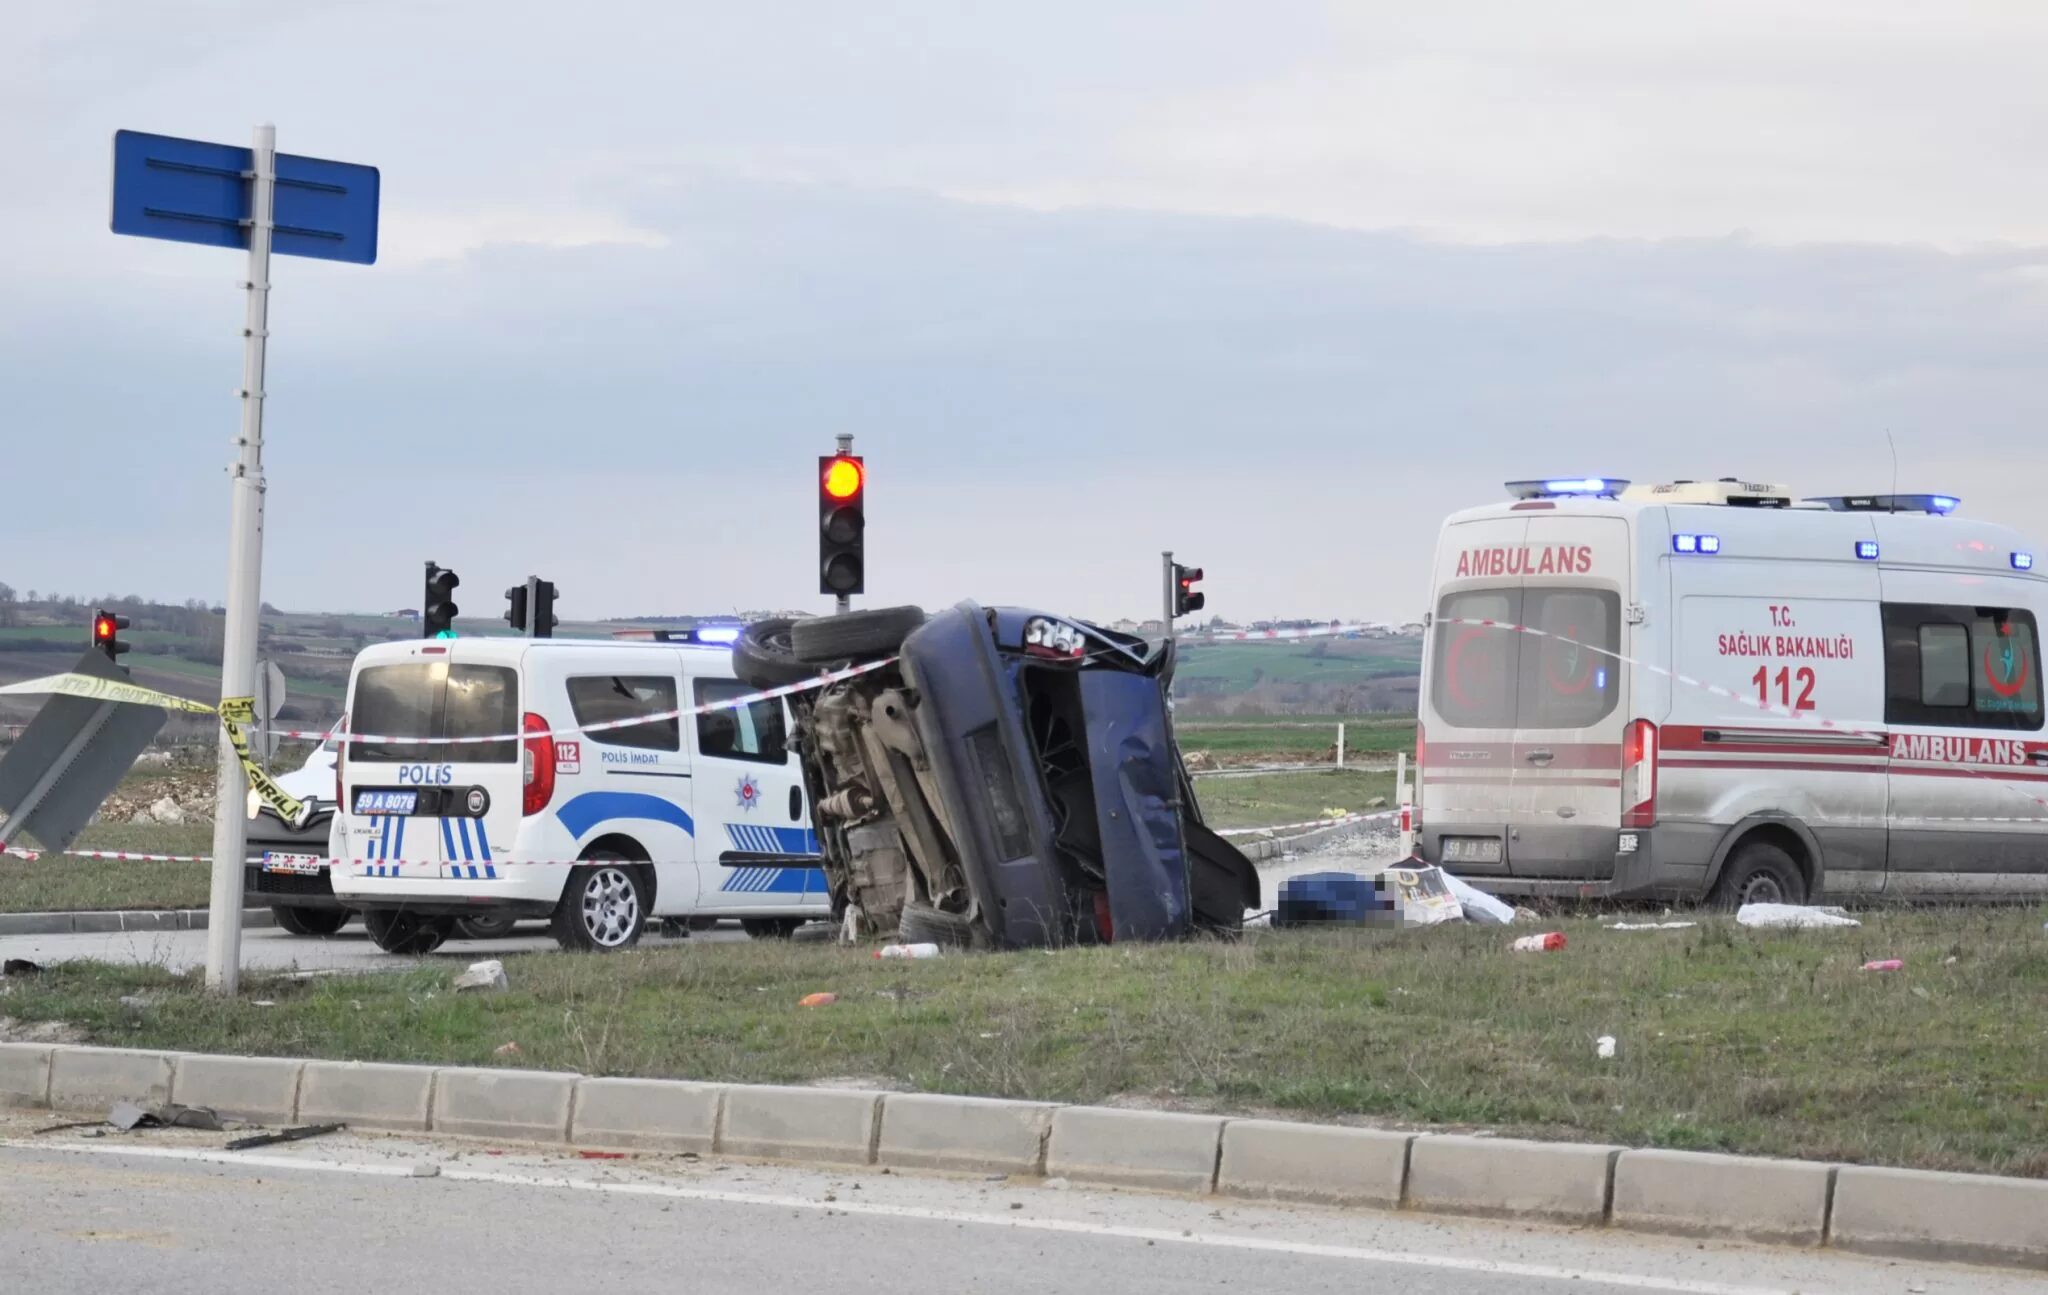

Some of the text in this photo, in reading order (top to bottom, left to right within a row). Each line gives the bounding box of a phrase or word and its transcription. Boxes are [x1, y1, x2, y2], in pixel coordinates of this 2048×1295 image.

[1456, 545, 1592, 577] AMBULANS
[1769, 606, 1796, 627] T.C.
[1718, 629, 1853, 660] SAĞLIK BAKANLIĞI
[1752, 665, 1816, 711] 112
[557, 744, 577, 760] 112
[602, 751, 659, 764] POLİS İMDAT
[1892, 734, 2026, 765] AMBULANS
[399, 764, 452, 785] POLİS
[357, 794, 417, 809] 59 A 8076
